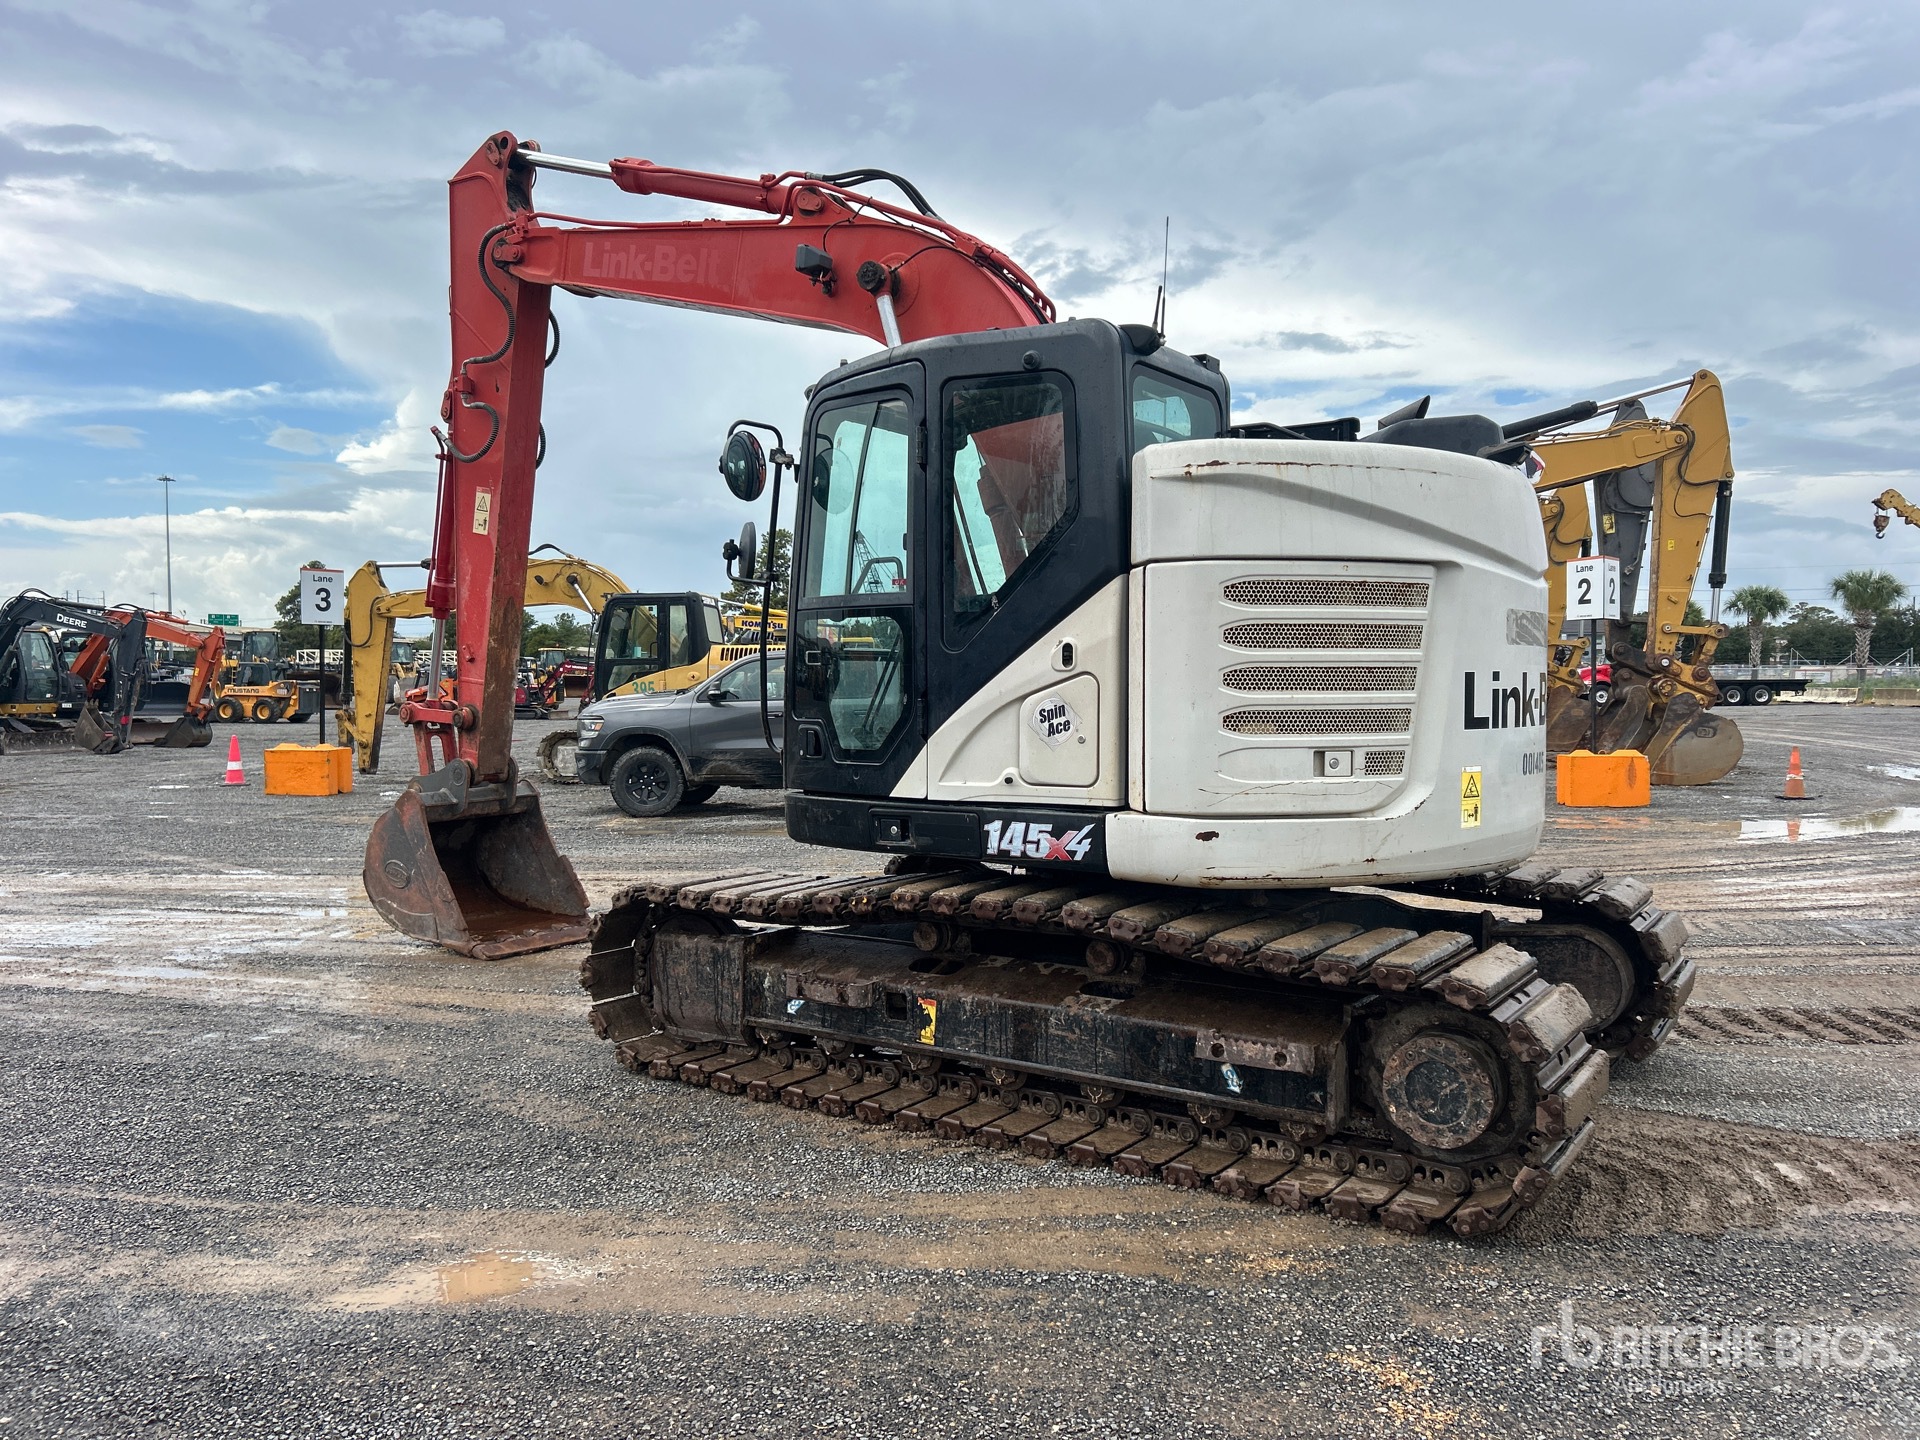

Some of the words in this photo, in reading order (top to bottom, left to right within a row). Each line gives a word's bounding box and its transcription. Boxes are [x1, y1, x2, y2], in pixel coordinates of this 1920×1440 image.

[583, 241, 720, 285] Link-Belt
[312, 574, 333, 583] Lane
[1575, 565, 1593, 573] Lane
[315, 587, 332, 613] 3
[1577, 577, 1591, 605] 2
[1609, 577, 1616, 604] 2
[56, 613, 88, 629] DEERE
[741, 619, 784, 629] KOMTSU
[1038, 703, 1067, 724] Spin
[1047, 719, 1071, 738] Ace
